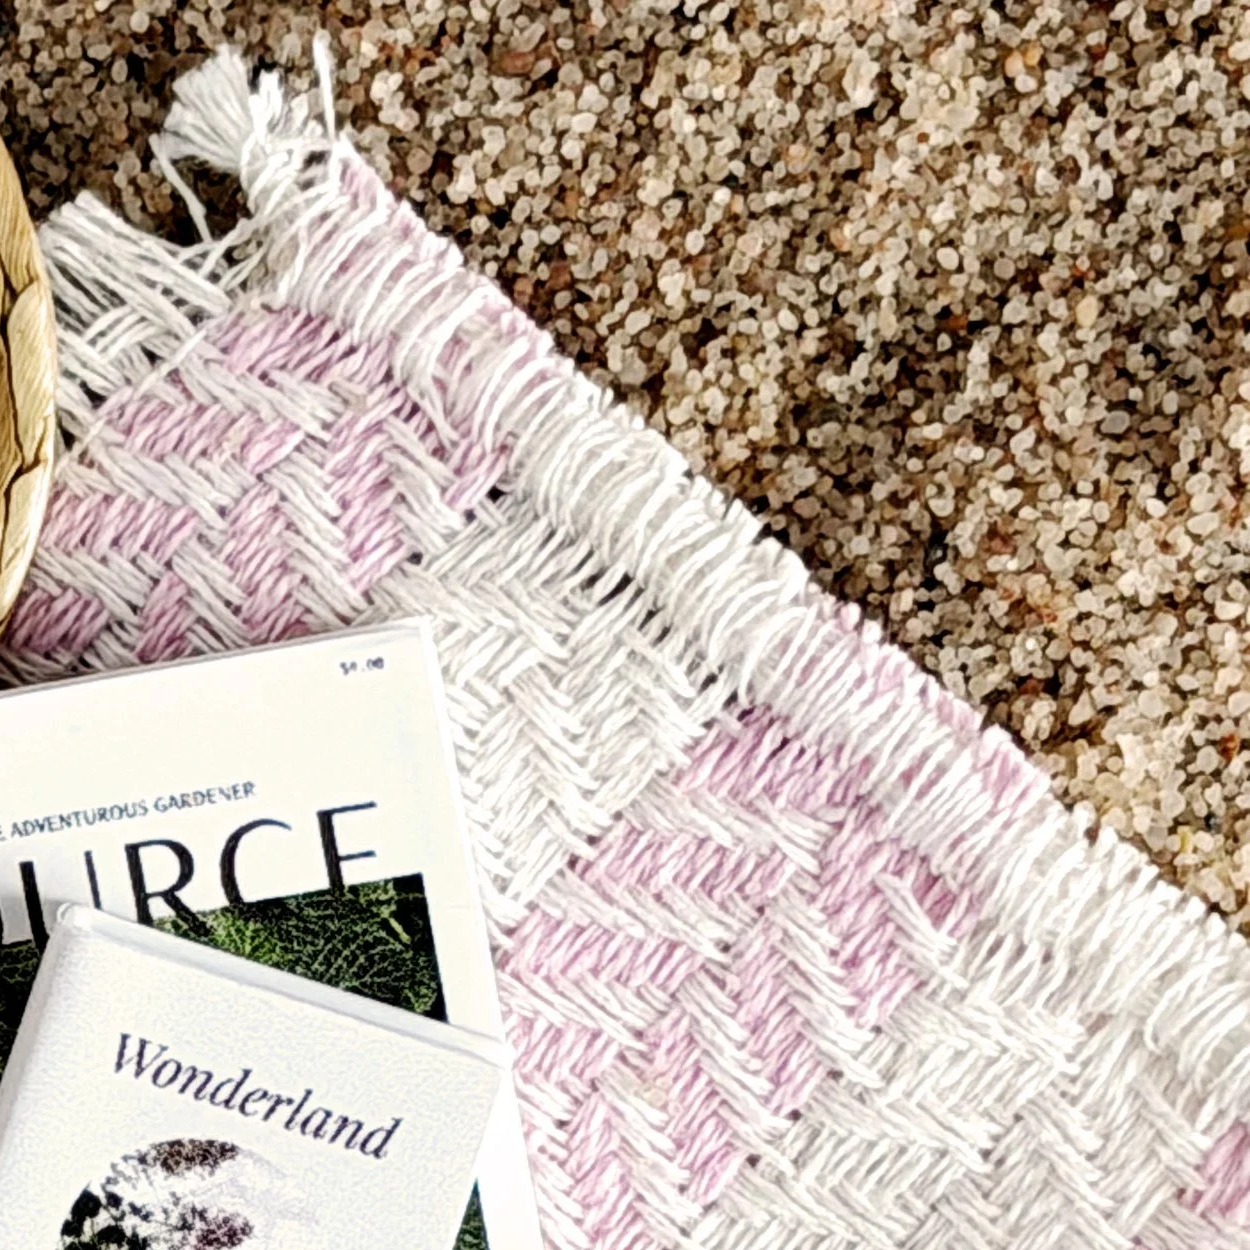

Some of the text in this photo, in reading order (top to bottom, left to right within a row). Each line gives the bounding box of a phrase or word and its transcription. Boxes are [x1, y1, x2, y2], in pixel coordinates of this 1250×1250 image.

[10, 799, 149, 838] ADVENTUROUS
[153, 780, 255, 813] GARDENER
[114, 1032, 404, 1160] Wonderland
